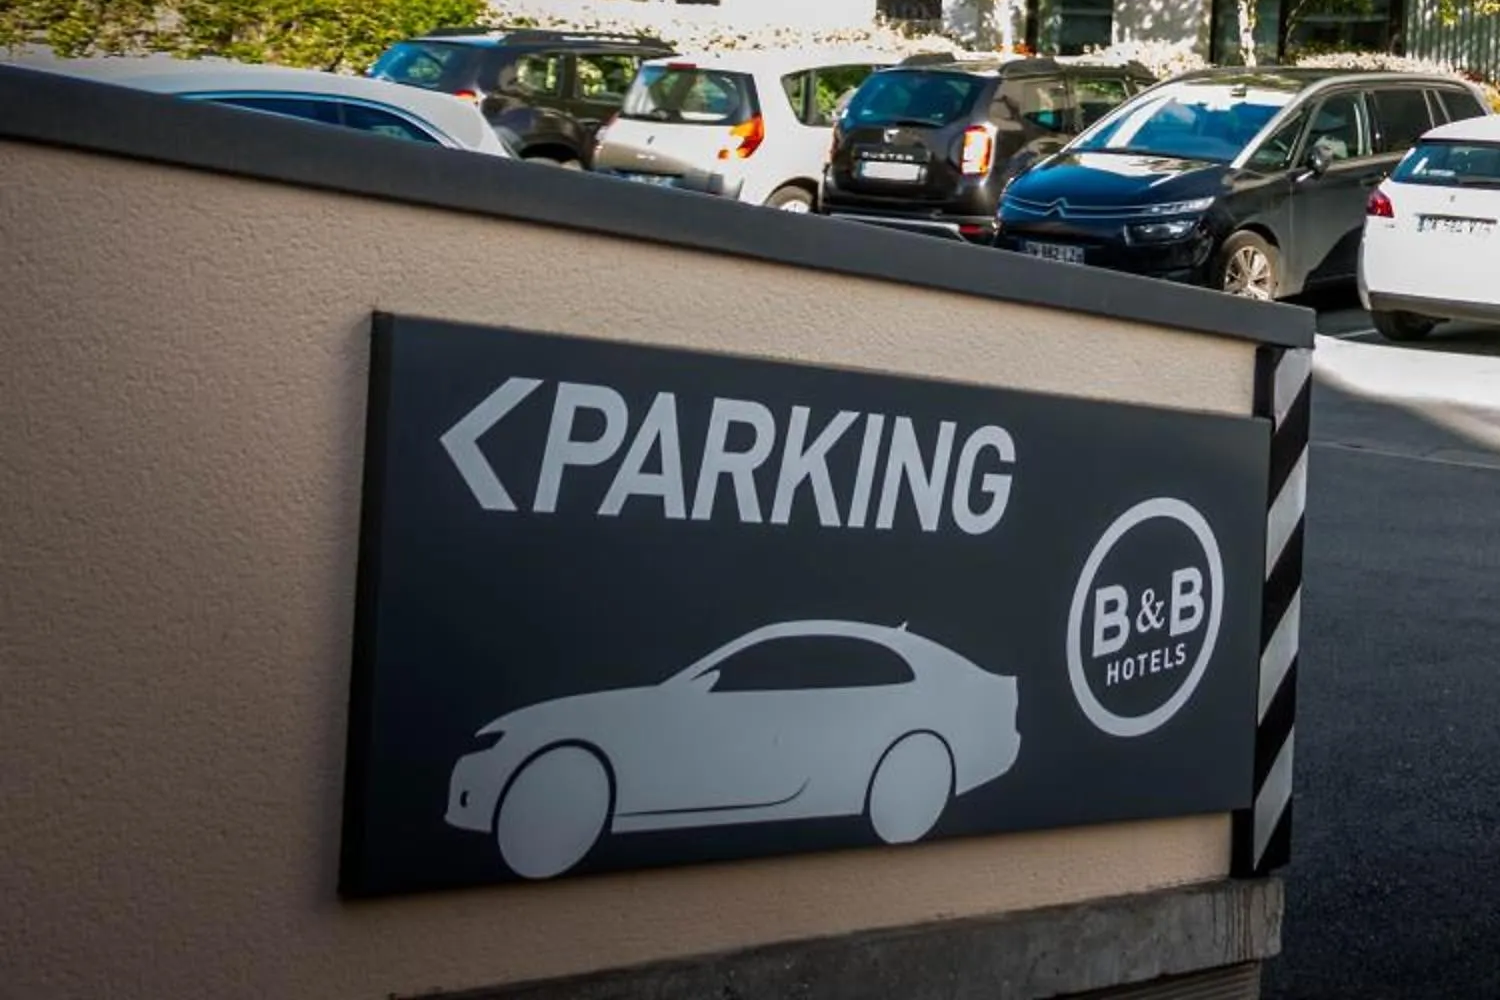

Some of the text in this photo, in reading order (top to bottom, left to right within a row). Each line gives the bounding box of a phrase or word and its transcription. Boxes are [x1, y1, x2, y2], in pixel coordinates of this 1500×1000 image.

[532, 380, 1016, 535] PARKING
[1092, 566, 1204, 658] B&B
[1106, 643, 1187, 686] HOTELS
